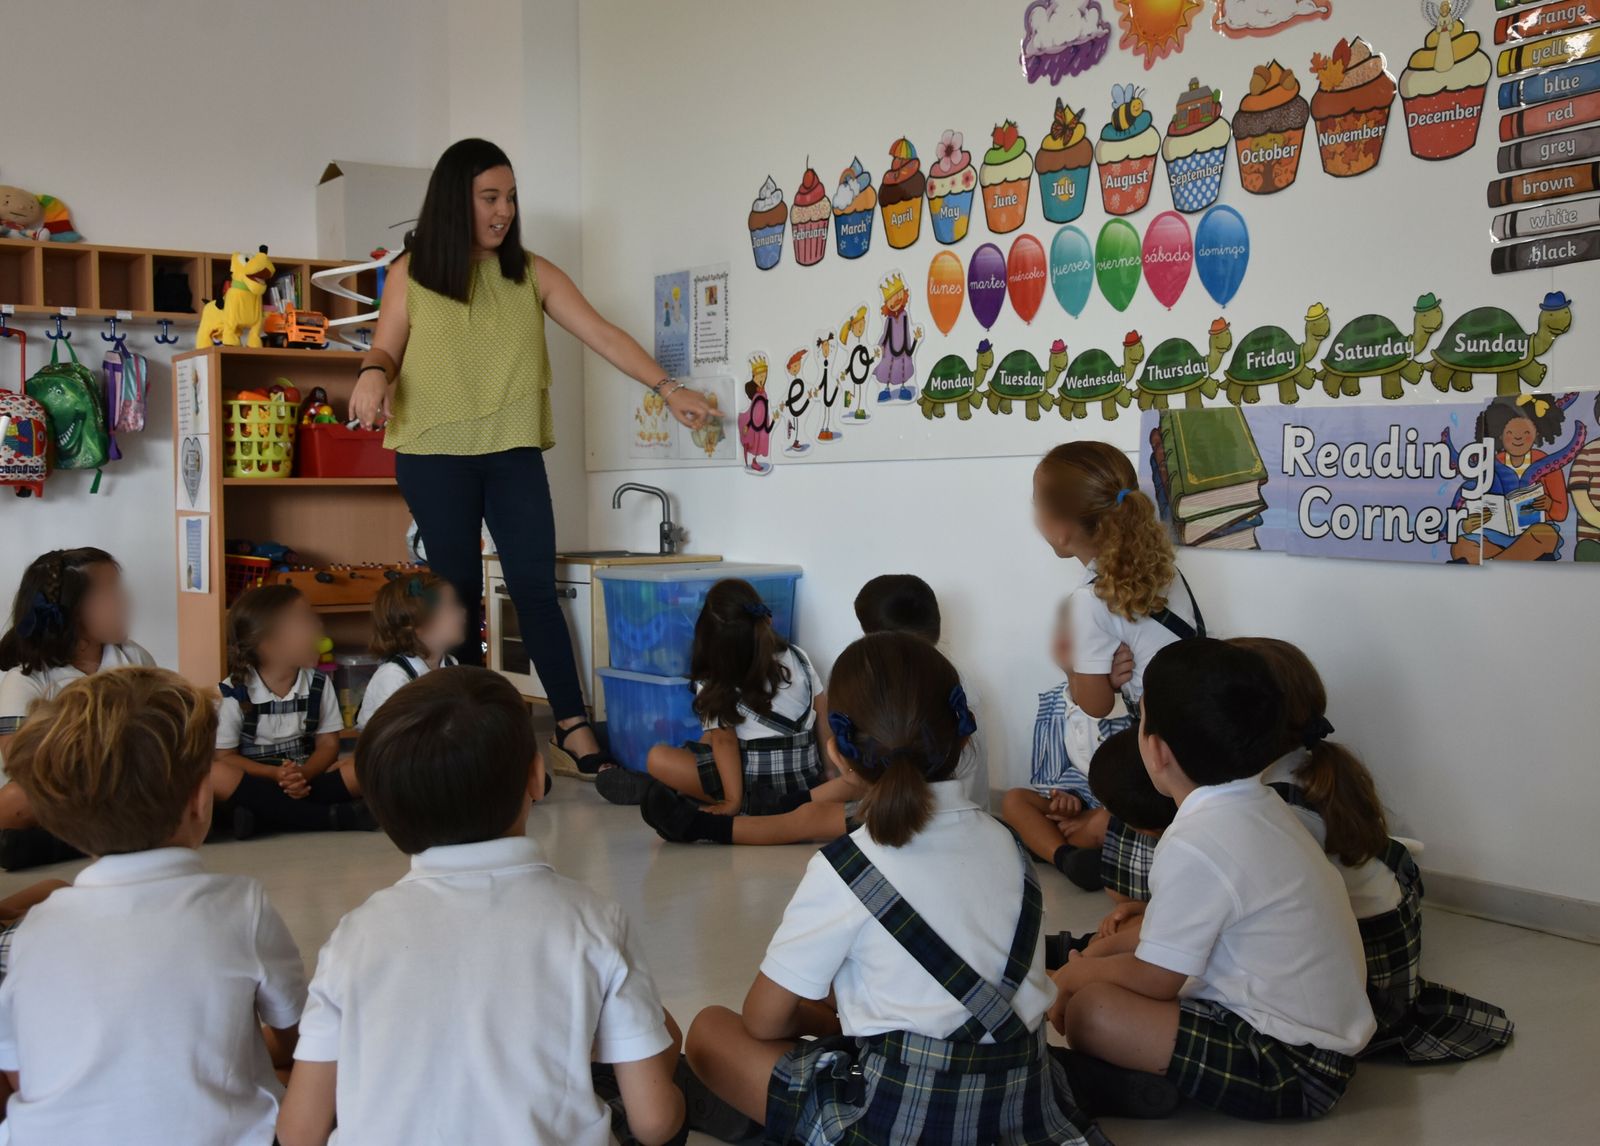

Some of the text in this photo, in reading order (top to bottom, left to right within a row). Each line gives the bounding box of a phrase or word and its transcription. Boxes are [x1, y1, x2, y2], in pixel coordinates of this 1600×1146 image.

[1524, 4, 1586, 26] range
[1543, 75, 1580, 94] blue
[1408, 104, 1481, 128] December
[1547, 101, 1574, 122] red
[1318, 123, 1386, 147] November
[1240, 143, 1298, 166] October
[1541, 139, 1576, 160] grey
[1105, 170, 1148, 191] August
[1170, 163, 1224, 187] September
[1051, 182, 1077, 198] July
[1523, 176, 1575, 195] brown
[992, 193, 1018, 208] June
[890, 207, 914, 227] April
[939, 205, 961, 221] May
[1530, 208, 1578, 229] white
[792, 226, 828, 242] February
[840, 222, 868, 238] March
[752, 232, 783, 249] January
[1199, 243, 1246, 258] domingo
[1145, 249, 1192, 265] sábado
[1530, 241, 1577, 263] black
[1052, 259, 1092, 284] jueves
[1096, 256, 1143, 272] viernes
[928, 277, 963, 296] lunes
[969, 274, 1006, 291] martes
[1334, 336, 1415, 362] Saturday
[1454, 333, 1529, 360] Sunday
[1246, 349, 1297, 371] Friday
[1000, 370, 1045, 388] Tuesday
[1147, 359, 1210, 382] Thursday
[931, 376, 976, 392] Monday
[1066, 371, 1128, 391] Wednesday
[1282, 423, 1496, 499] Reading
[1298, 485, 1469, 544] Corner
